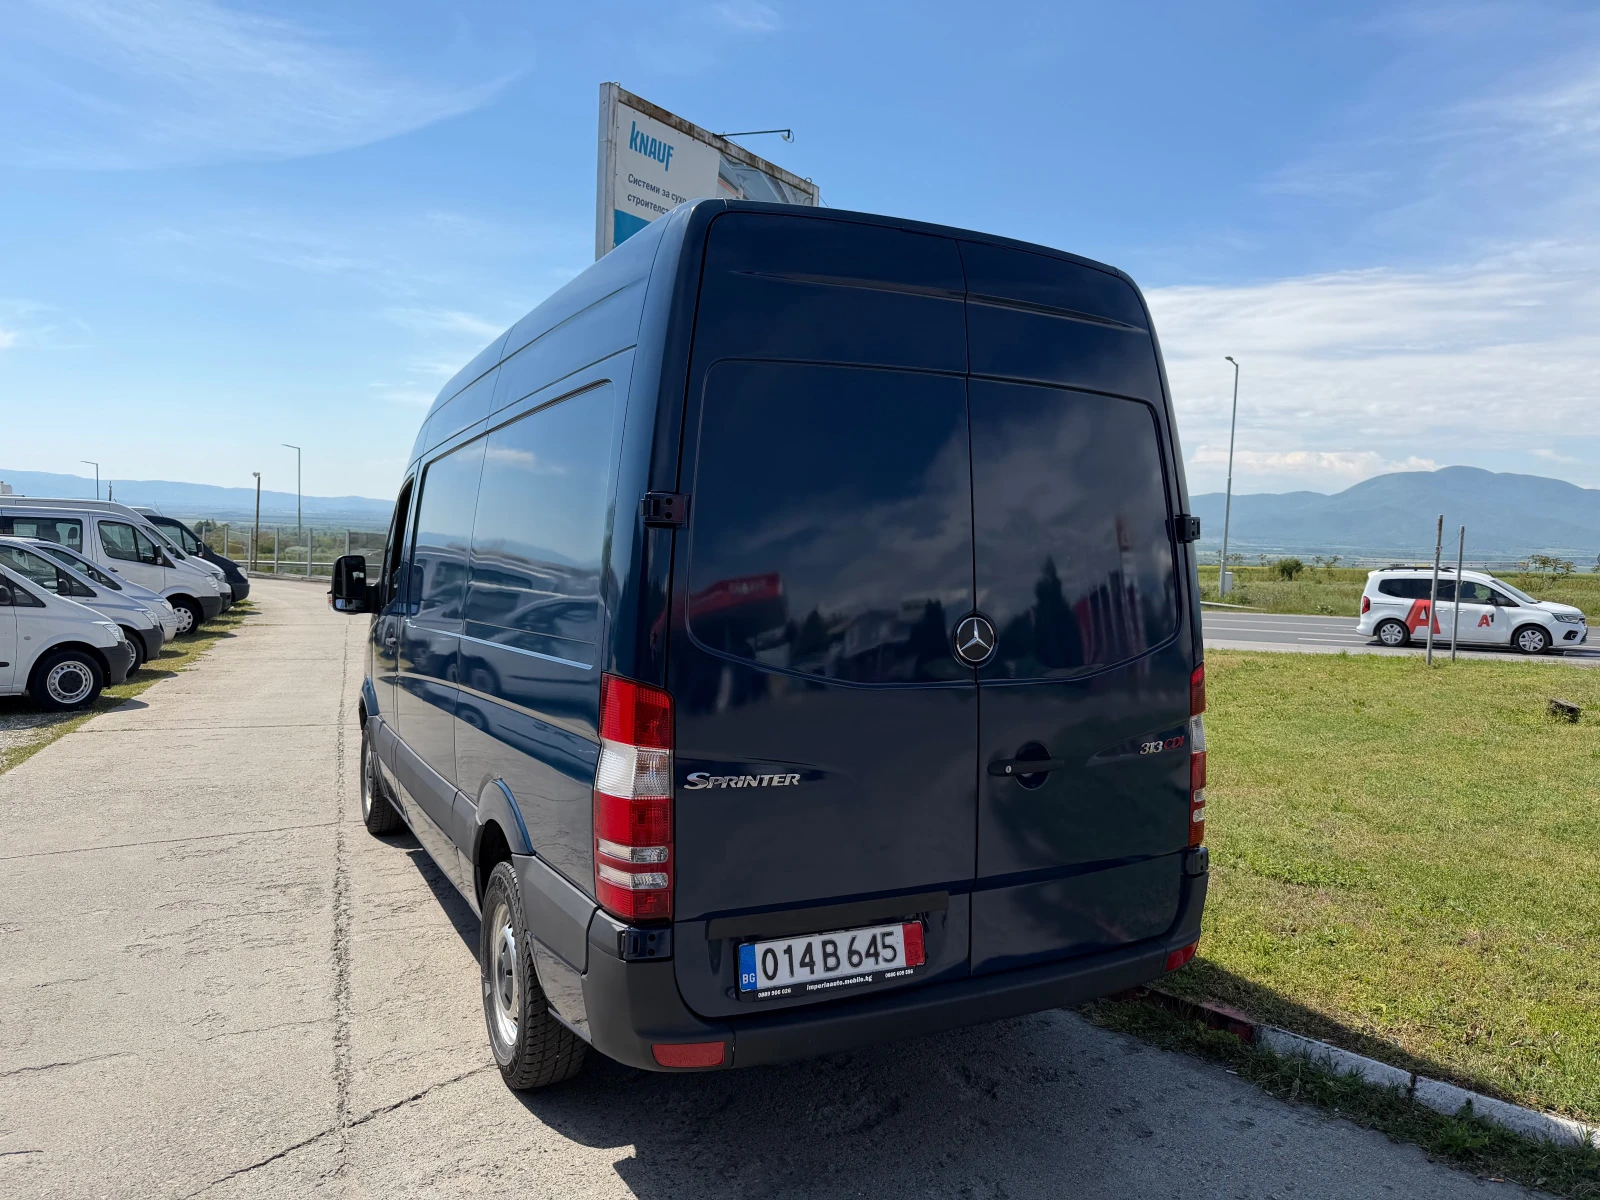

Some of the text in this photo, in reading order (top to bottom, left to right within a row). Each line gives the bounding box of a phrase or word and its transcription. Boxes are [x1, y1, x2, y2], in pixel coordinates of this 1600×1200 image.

[628, 174, 661, 195] Системи
[661, 189, 670, 198] за
[1477, 613, 1494, 627] A1
[1139, 735, 1185, 755] 313 CDI
[683, 771, 800, 790] SPRINTER
[742, 973, 755, 984] BG
